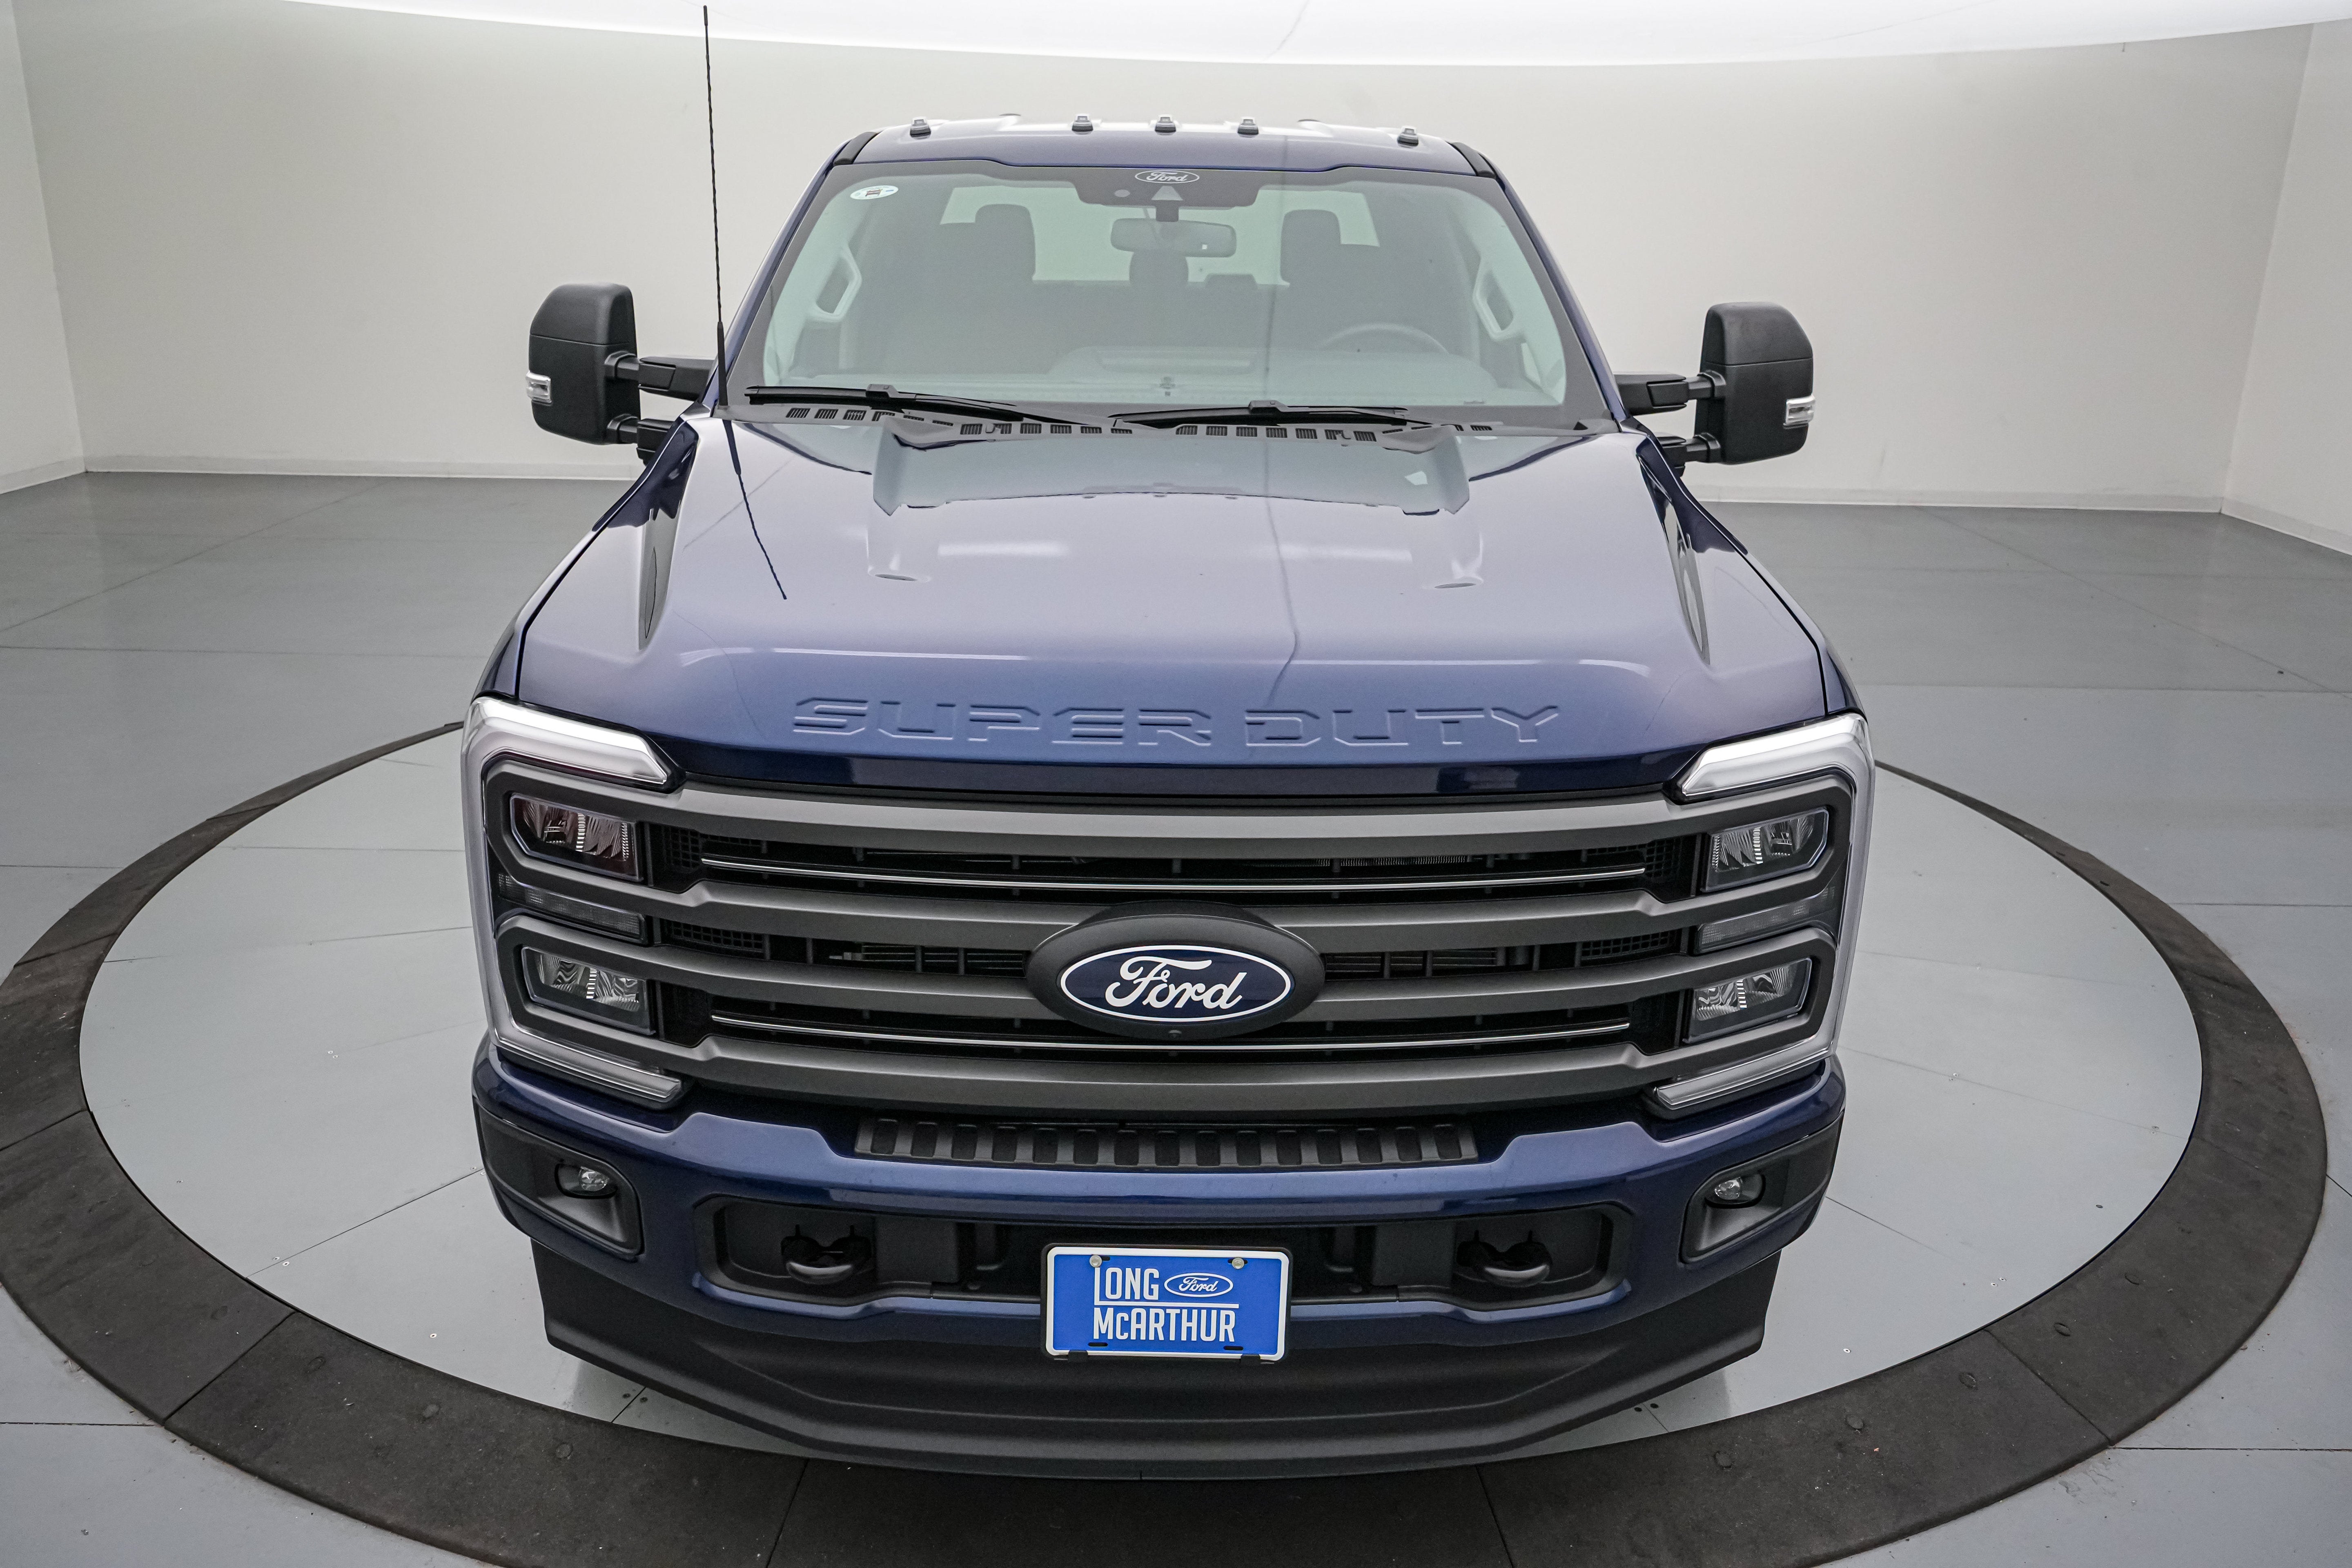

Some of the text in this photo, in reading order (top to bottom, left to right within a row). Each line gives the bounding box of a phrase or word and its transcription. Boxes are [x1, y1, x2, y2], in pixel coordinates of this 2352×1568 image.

[1147, 172, 1188, 181] Ford
[792, 697, 1559, 747] SUPER DUTY
[1105, 956, 1247, 1009] Ford
[1094, 1267, 1218, 1305] LONG Ford
[1094, 1307, 1235, 1342] McARTHUR
